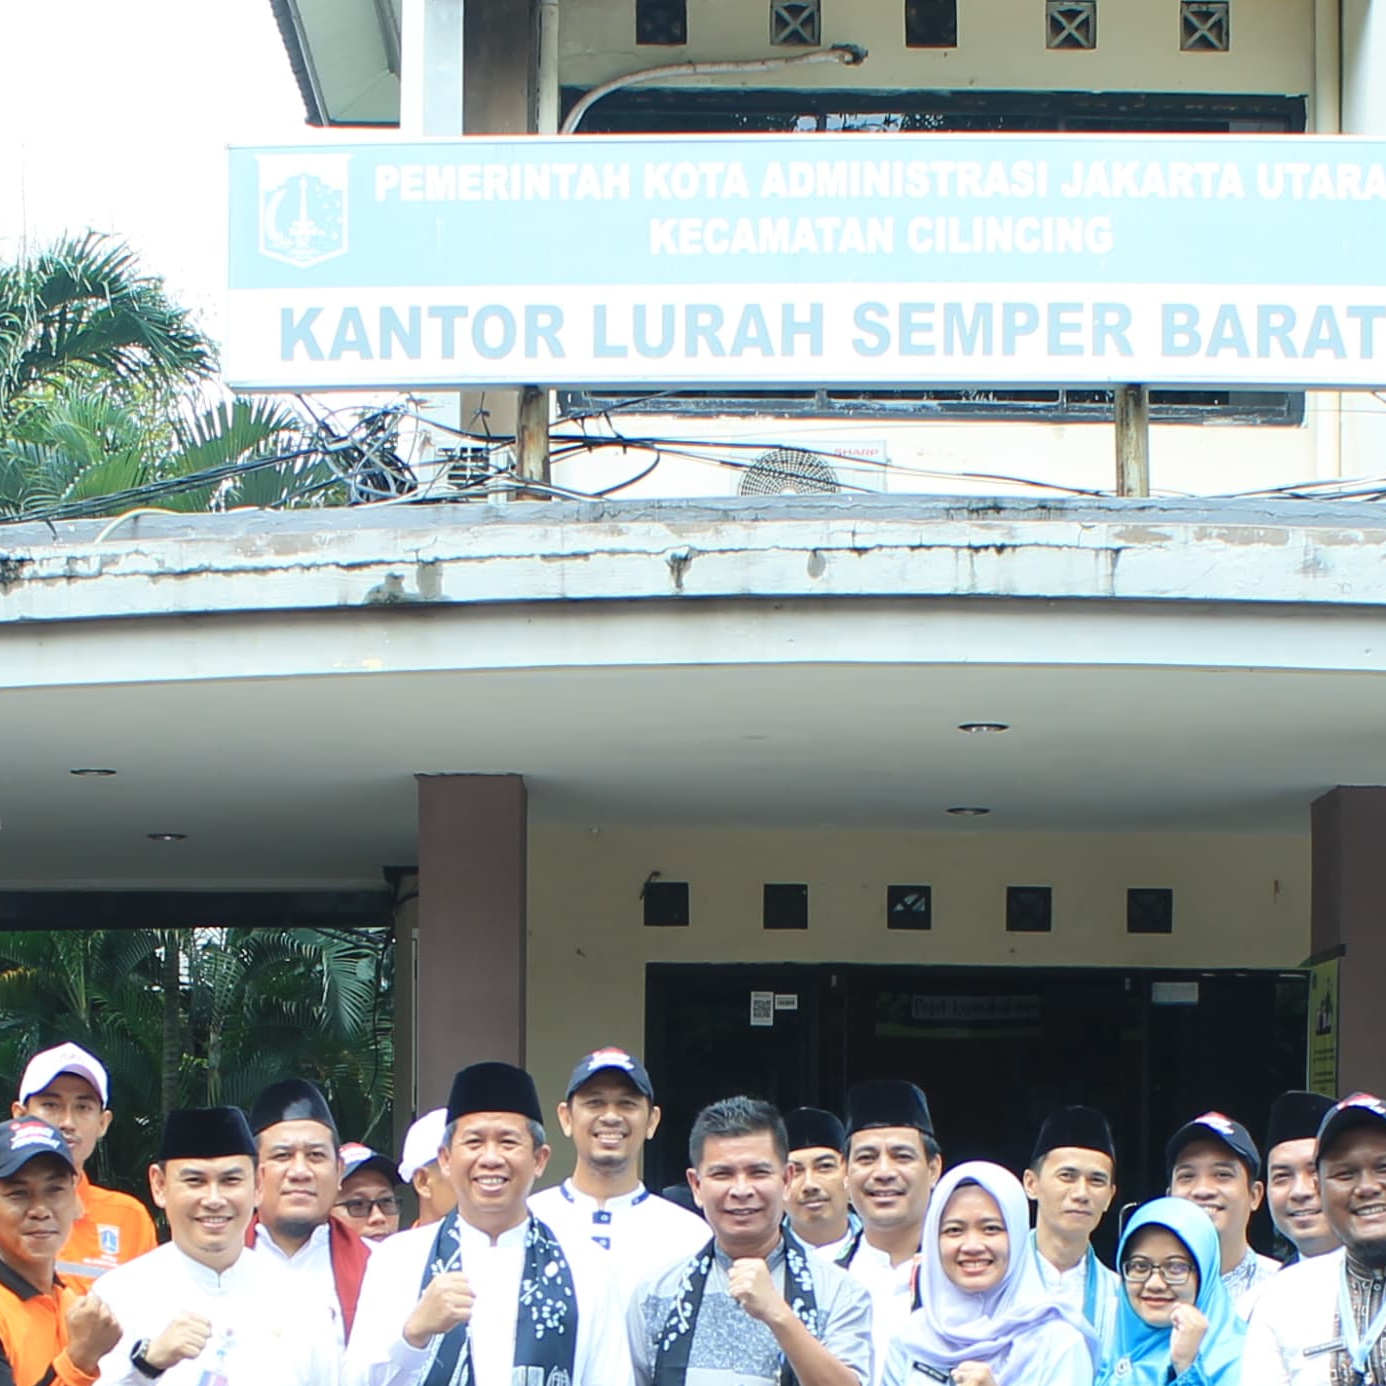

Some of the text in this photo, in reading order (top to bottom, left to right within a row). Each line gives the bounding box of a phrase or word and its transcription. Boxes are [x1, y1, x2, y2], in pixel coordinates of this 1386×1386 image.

[374, 162, 632, 202] PEMERINTAH
[642, 160, 751, 200] KOTA
[759, 159, 1049, 199] ADMINISTRASI
[1060, 160, 1247, 199] JAKARTA
[649, 214, 1114, 256] KECAMATAN CILINCING
[279, 303, 566, 362] KANTOR
[592, 301, 824, 359] LURAH
[852, 300, 1134, 357] SEMPER
